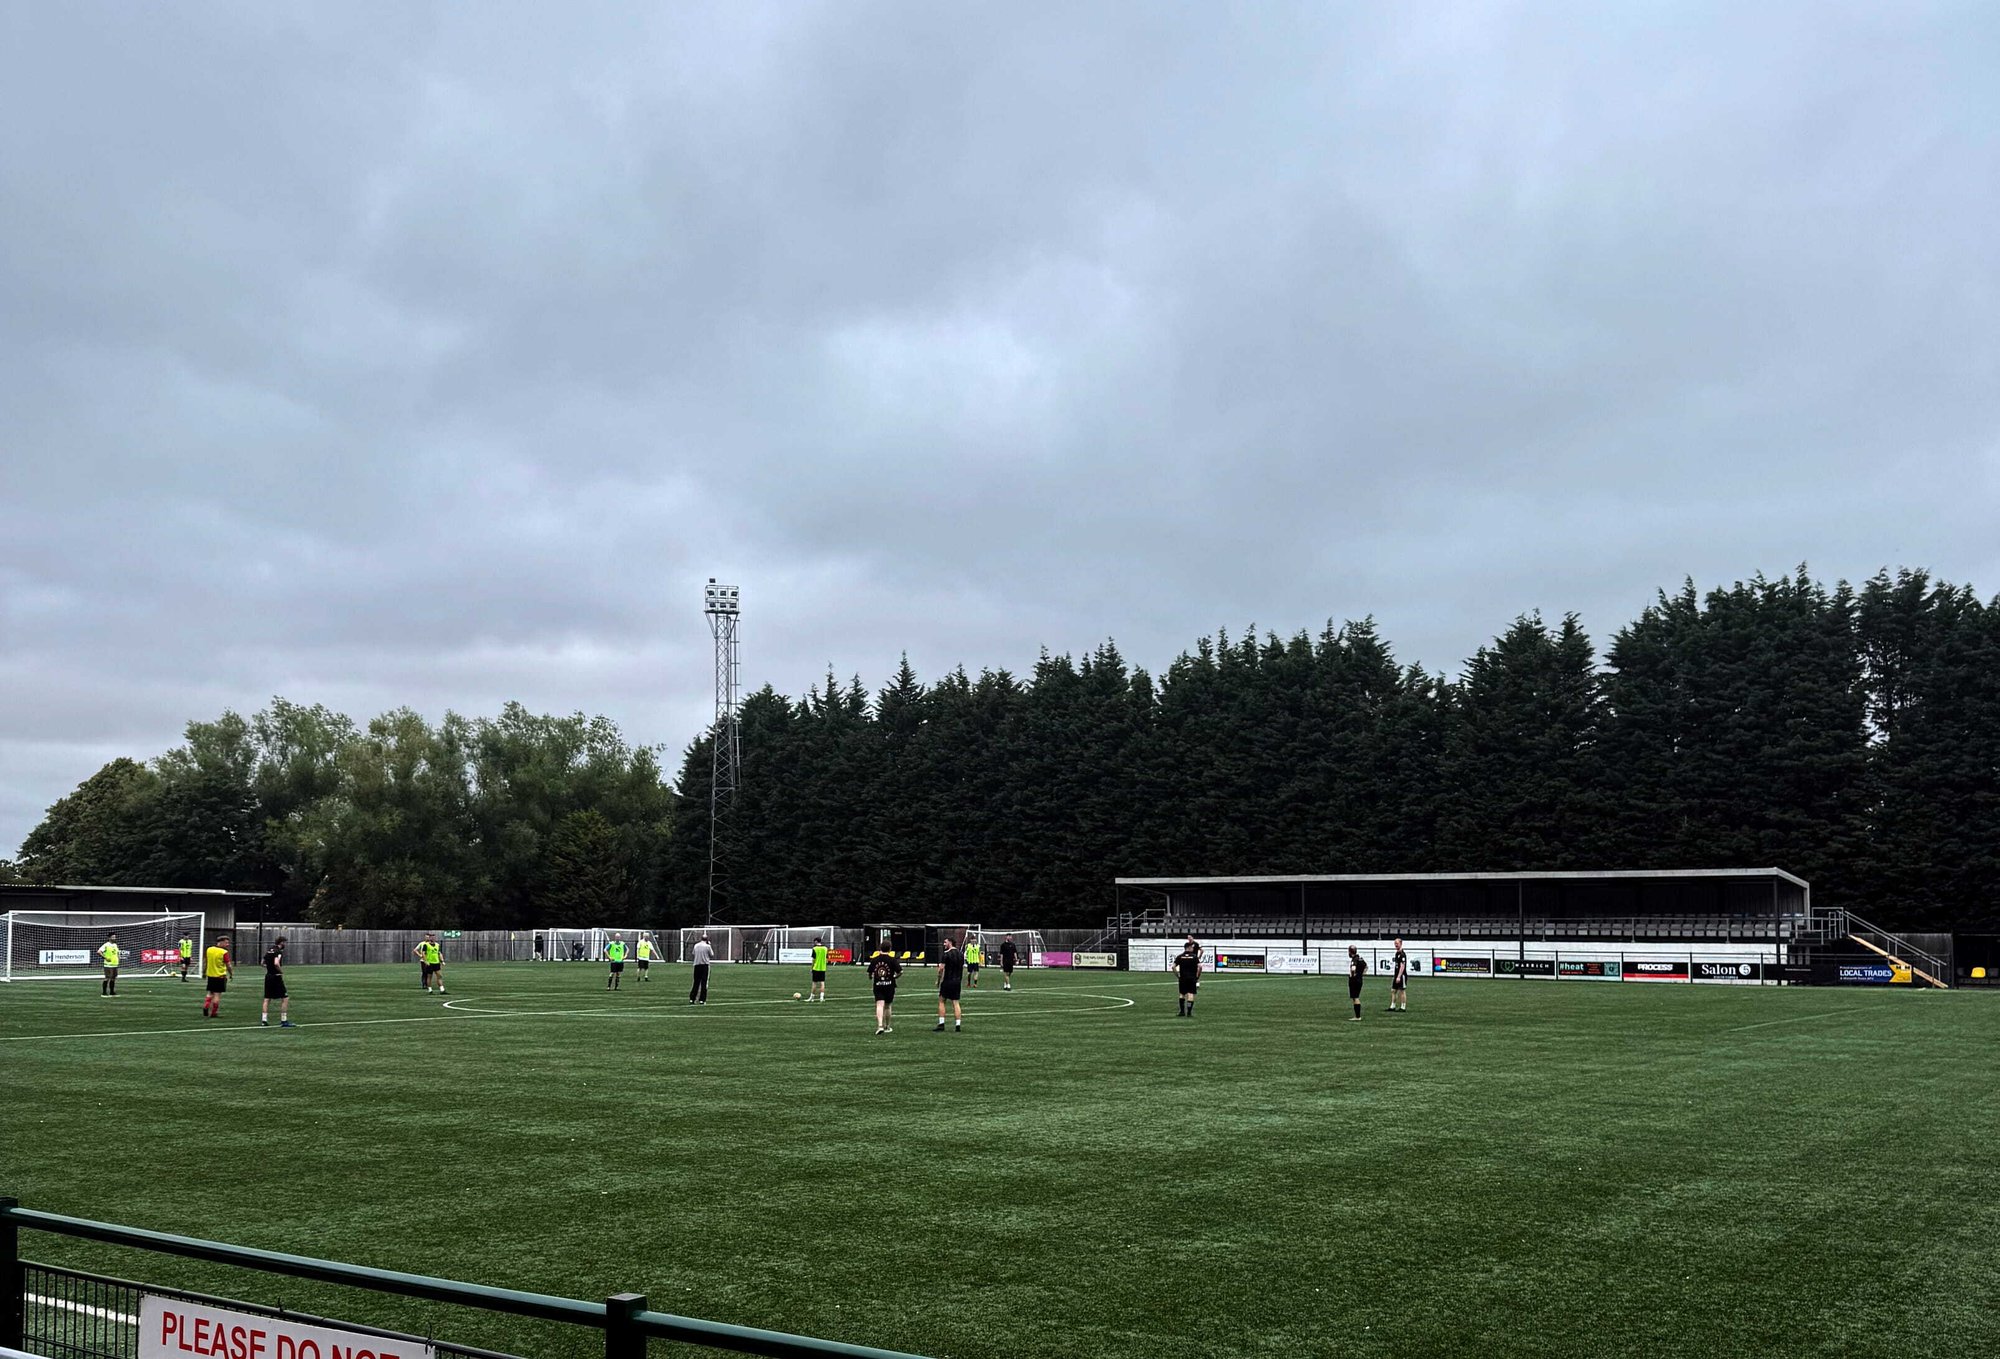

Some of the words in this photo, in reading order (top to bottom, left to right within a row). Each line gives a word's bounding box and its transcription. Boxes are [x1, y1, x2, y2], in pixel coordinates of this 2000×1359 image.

[1637, 963, 1674, 971] PROCESS
[1701, 964, 1736, 974] Salon
[162, 1311, 267, 1359] PLEASE
[277, 1334, 321, 1359] DO
